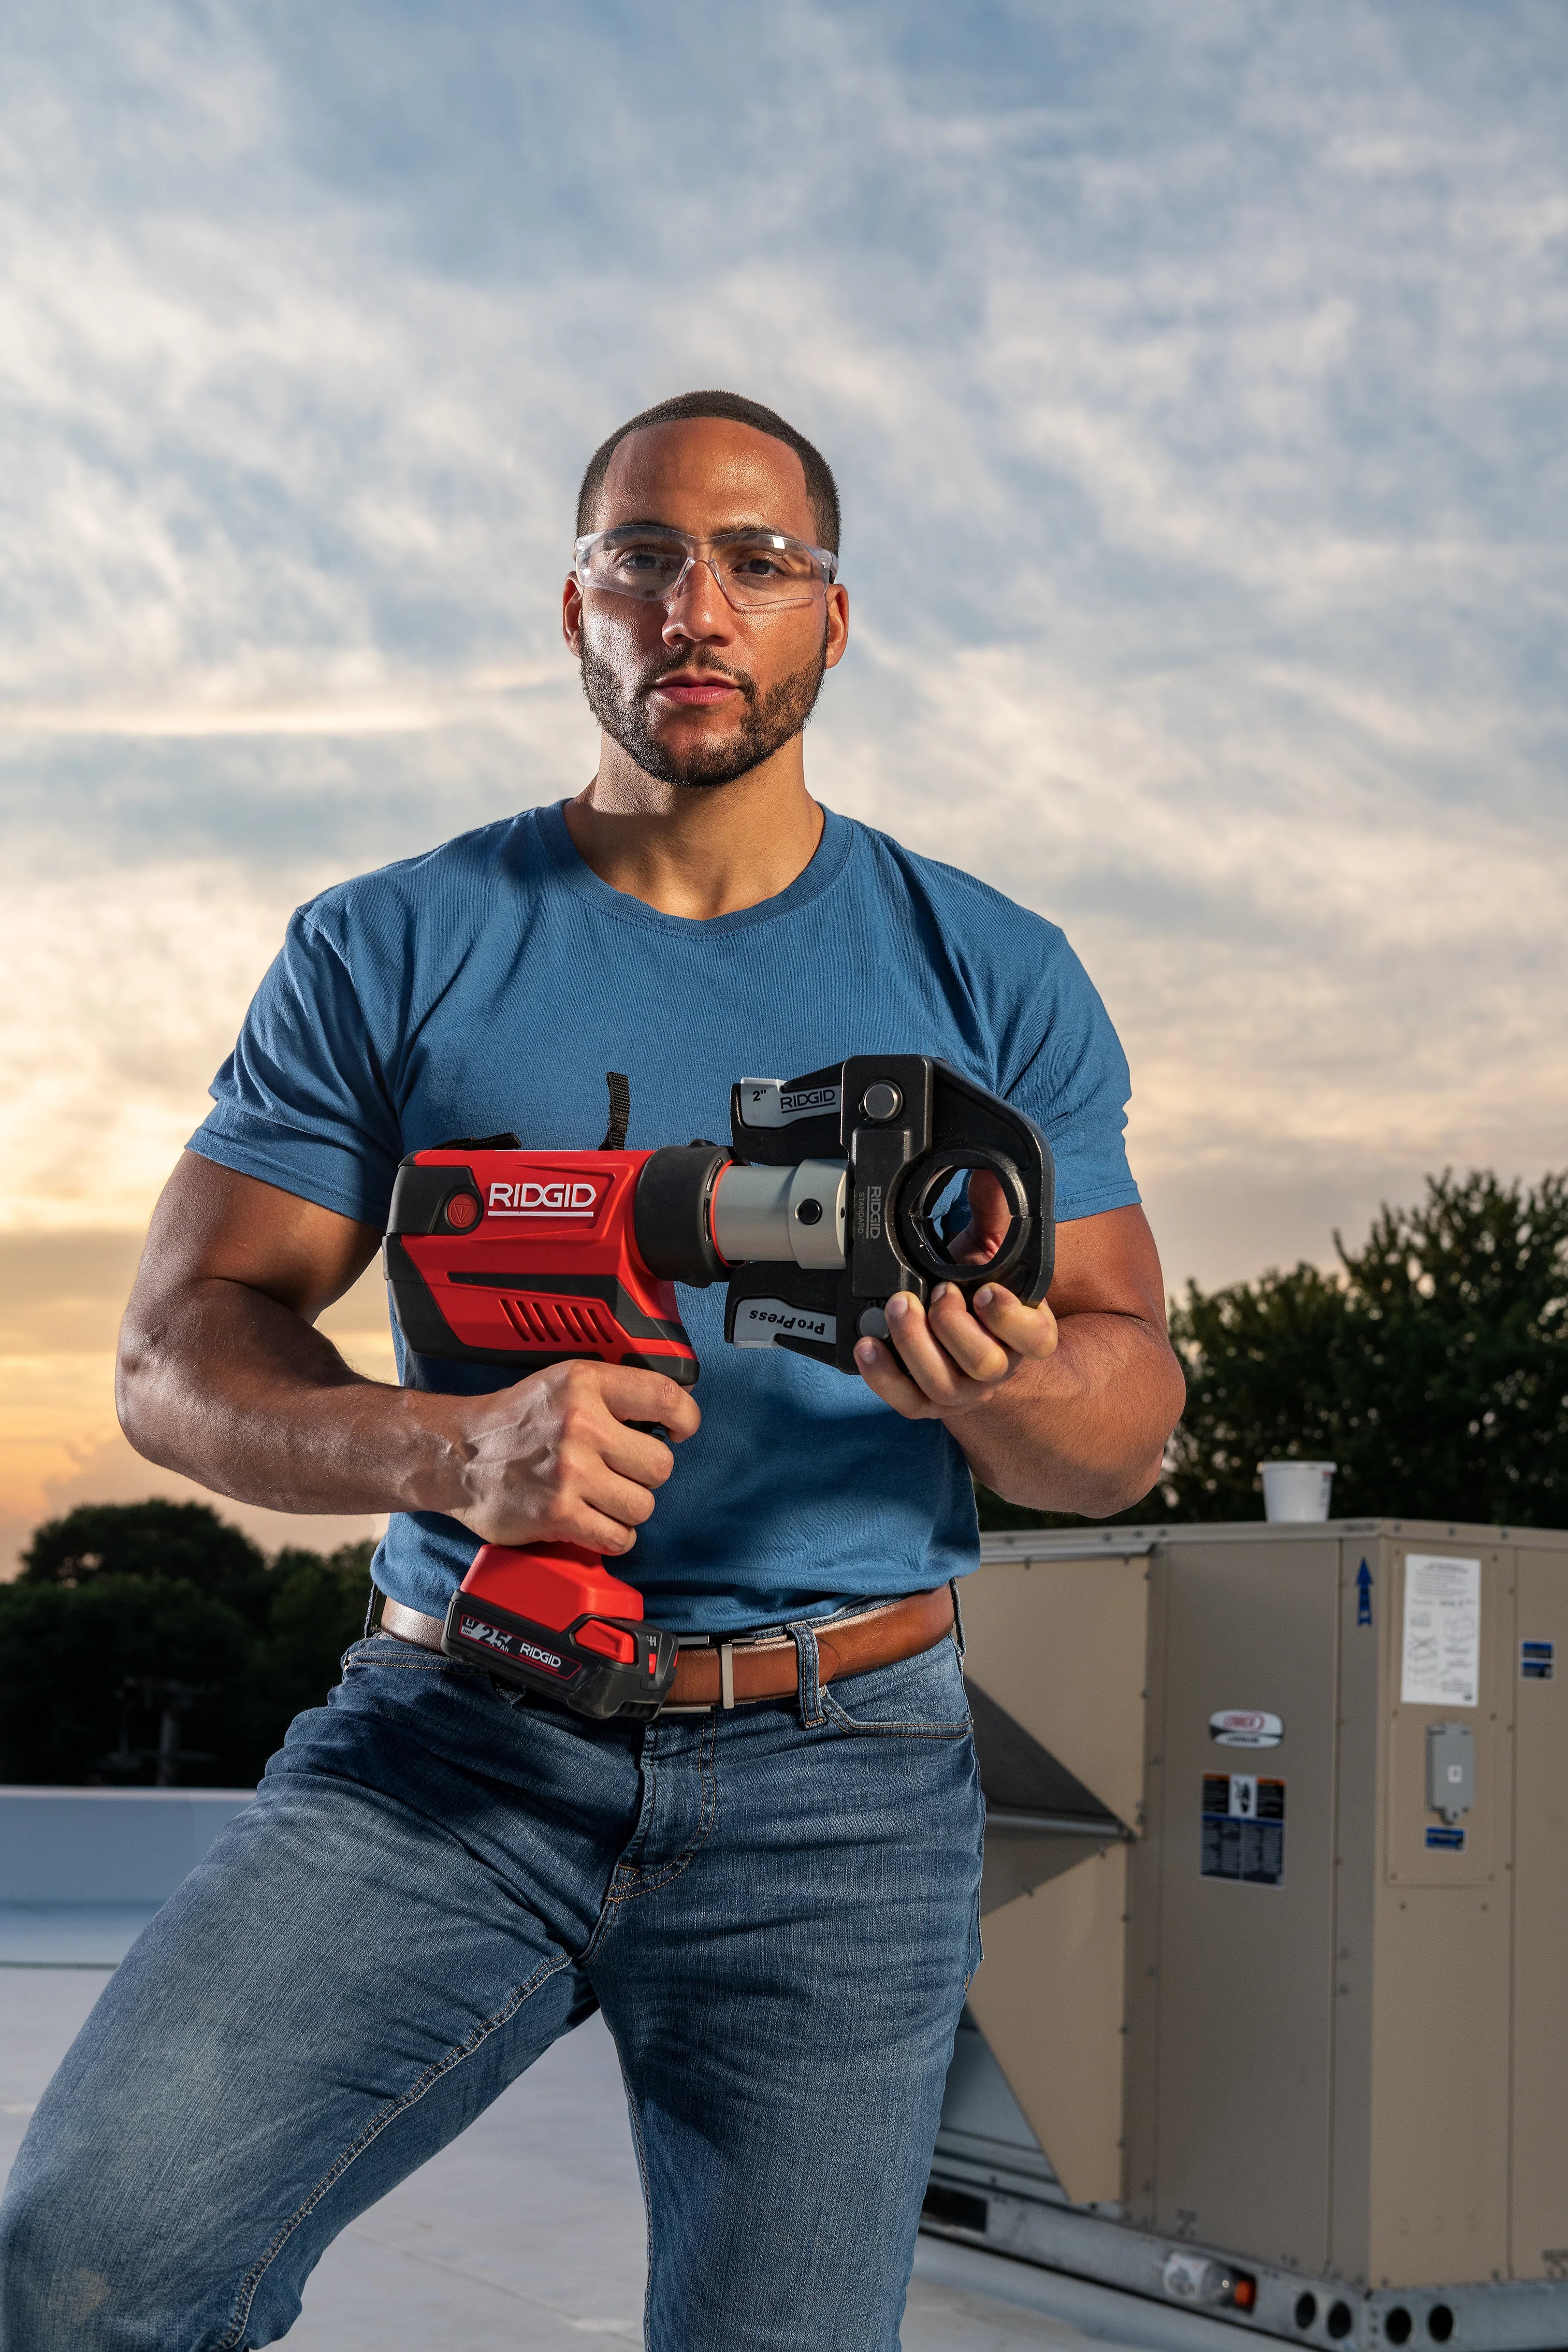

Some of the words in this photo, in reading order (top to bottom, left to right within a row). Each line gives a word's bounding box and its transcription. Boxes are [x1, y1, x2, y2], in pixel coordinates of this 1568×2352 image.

[752, 1089, 766, 1102] 2"
[780, 1089, 835, 1109] RIDGID
[489, 1183, 596, 1207] RIDGID
[870, 1186, 881, 1239] RIDGID
[749, 1310, 825, 1335] ProPress
[466, 1618, 475, 1627] Li
[500, 1644, 510, 1653] Ah
[519, 1642, 561, 1668] RIDGID
